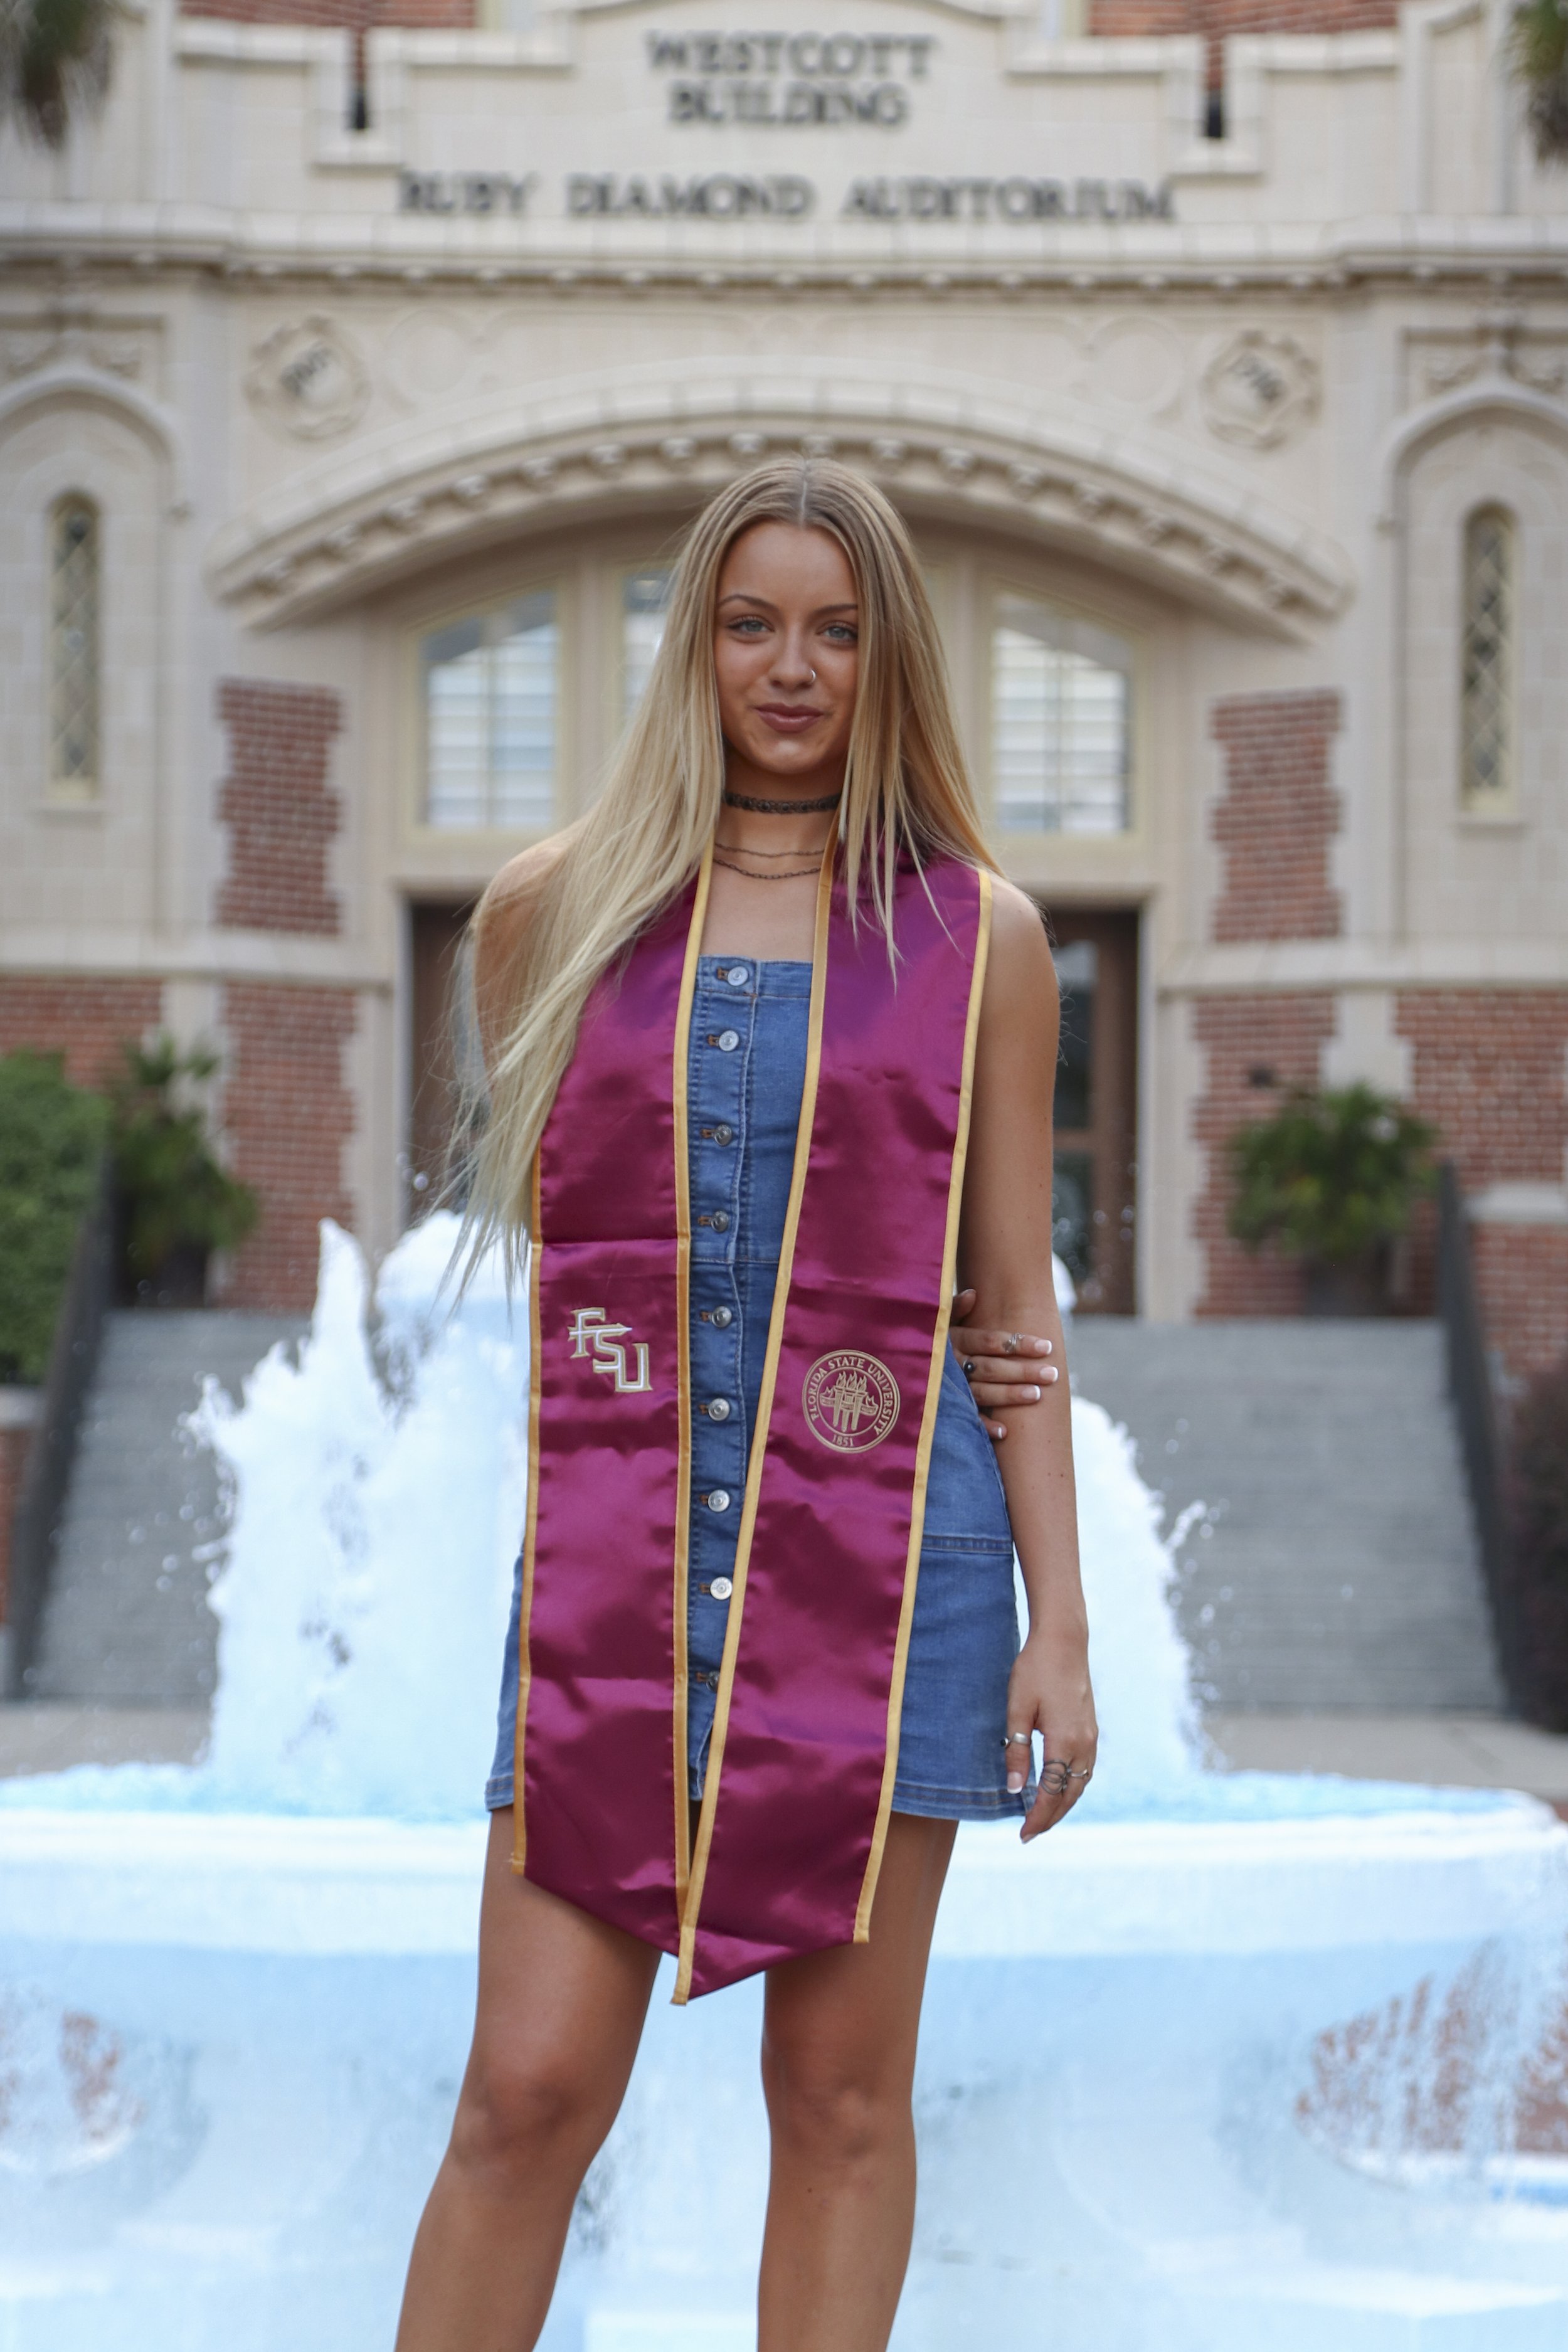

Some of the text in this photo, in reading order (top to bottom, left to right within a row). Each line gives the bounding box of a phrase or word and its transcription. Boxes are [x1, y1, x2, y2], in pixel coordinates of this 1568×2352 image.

[647, 30, 936, 77] WESTCOTT
[669, 82, 907, 125] BUILDING
[398, 172, 1175, 223] RUBY DIAMOND AUDITORIUM
[567, 1307, 653, 1392] FSU
[808, 1367, 827, 1421] FLORIDA
[828, 1357, 865, 1369] STATE
[868, 1364, 893, 1435] UNIVERSITY
[832, 1434, 854, 1447] 1851
